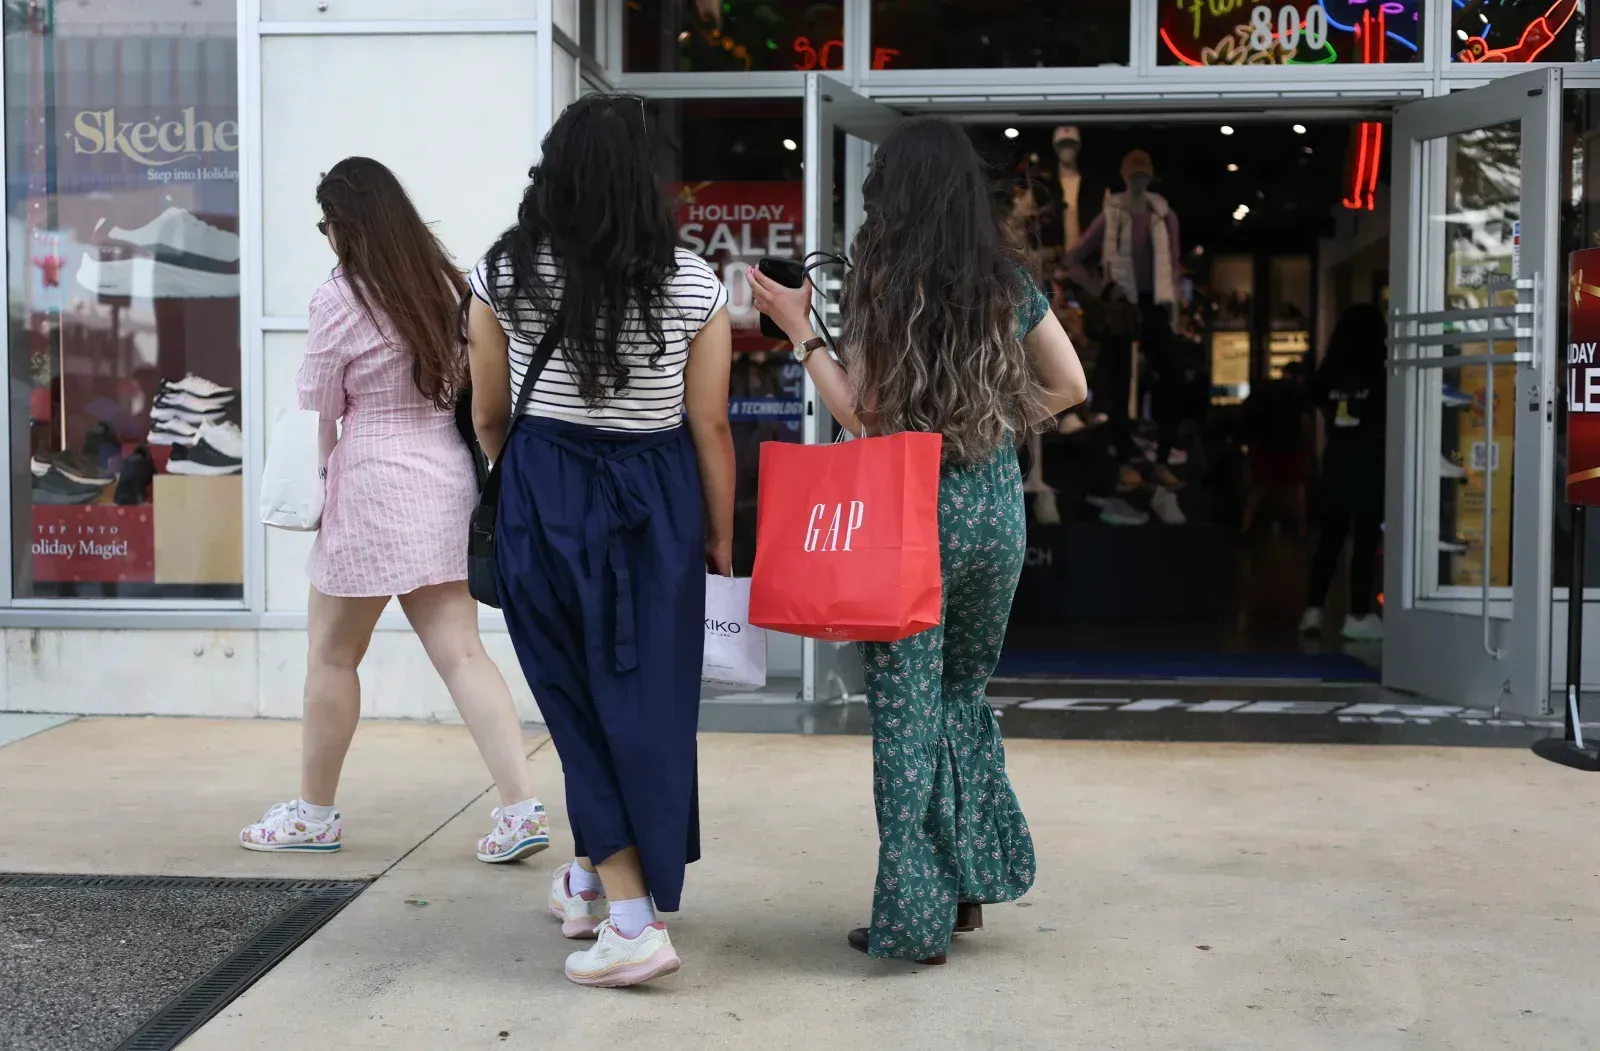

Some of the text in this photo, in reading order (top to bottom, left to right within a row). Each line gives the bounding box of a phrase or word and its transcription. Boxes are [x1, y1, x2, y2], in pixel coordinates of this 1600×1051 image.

[1250, 5, 1328, 50] 800
[73, 107, 239, 165] Skeche
[147, 167, 239, 183] Step into Holiday
[690, 205, 784, 221] HOLIDAY
[680, 223, 794, 256] SALE
[78, 525, 119, 535] INTO
[803, 500, 865, 553] GAP
[79, 540, 128, 559] Magic!
